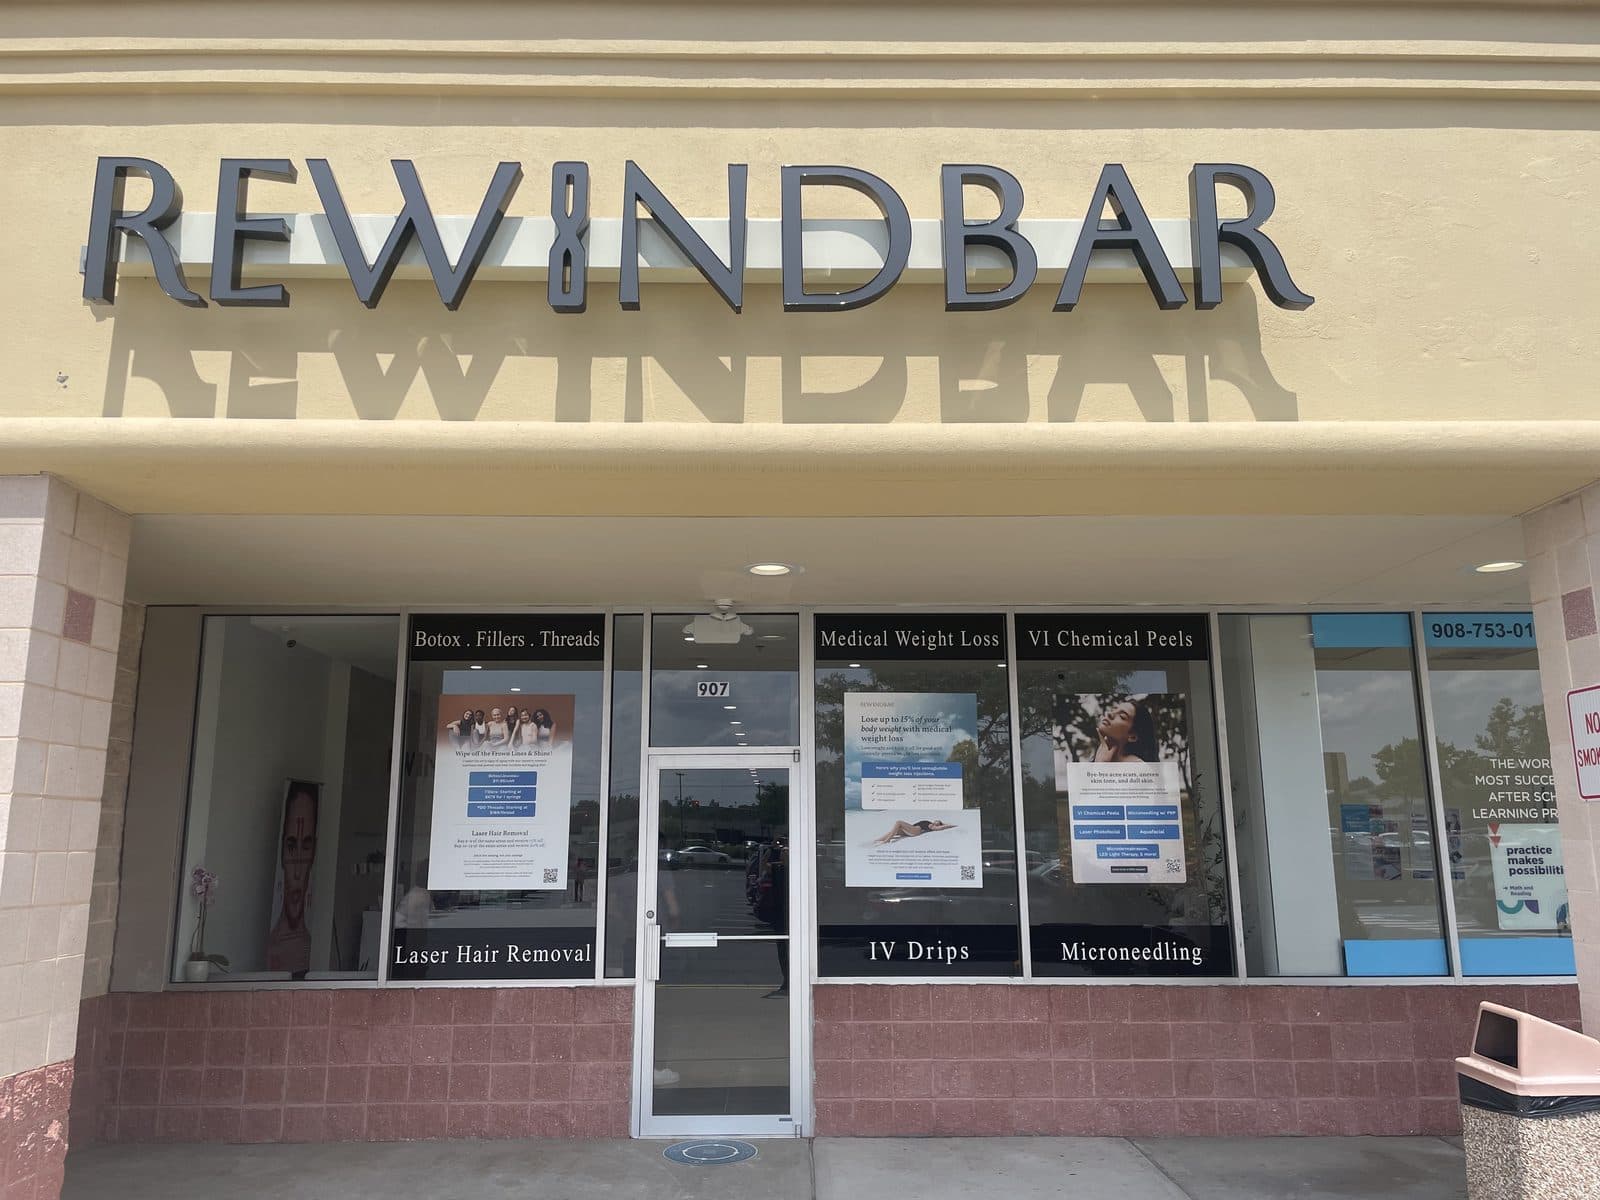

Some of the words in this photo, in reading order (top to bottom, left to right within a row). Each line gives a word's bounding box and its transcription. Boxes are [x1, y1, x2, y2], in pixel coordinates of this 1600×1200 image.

[414, 631, 461, 648] Botox
[476, 630, 525, 648] Fillers
[539, 630, 600, 648] Threads
[820, 630, 888, 647] Medical
[895, 630, 954, 651] Weight
[960, 630, 1000, 647] Loss
[1028, 630, 1050, 647] VI
[1057, 630, 1139, 647] Chemical
[1147, 630, 1193, 647] Peels
[699, 683, 727, 696] 907
[916, 715, 923, 724] of
[1585, 711, 1600, 734] NO
[861, 725, 877, 733] body
[879, 725, 901, 734] weight
[861, 735, 887, 743] weight
[1489, 758, 1515, 769] THE
[1518, 758, 1550, 769] WOR
[1475, 775, 1511, 786] MOST
[1488, 791, 1531, 802] AFTER
[1472, 808, 1539, 819] LEARNING
[1506, 845, 1553, 856] practice
[1508, 855, 1544, 864] makes
[1509, 865, 1564, 876] possibiliti
[395, 945, 449, 964] Laser
[457, 944, 500, 963] Hair
[507, 943, 592, 962] Removal
[869, 941, 896, 960] IV
[907, 940, 970, 965] Drips
[1061, 941, 1203, 966] Microneedling
